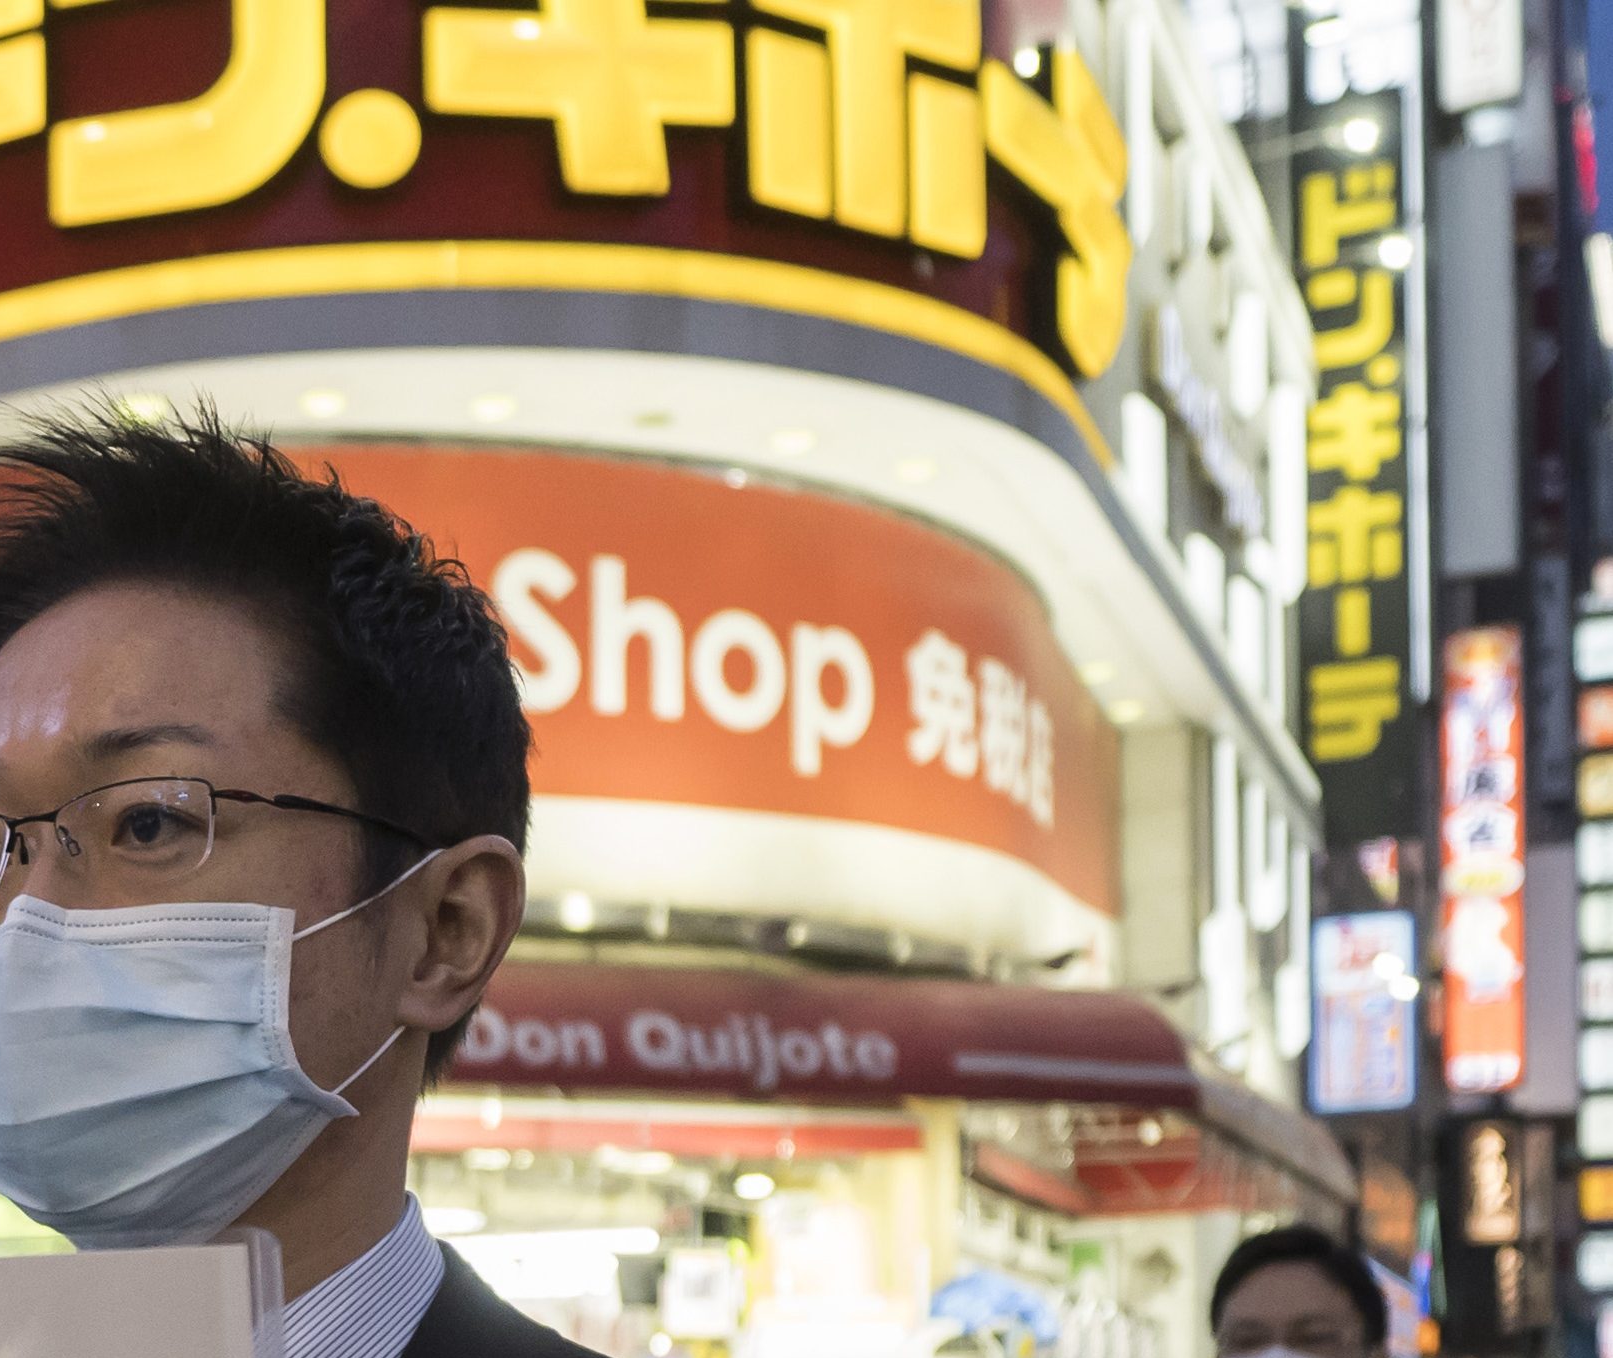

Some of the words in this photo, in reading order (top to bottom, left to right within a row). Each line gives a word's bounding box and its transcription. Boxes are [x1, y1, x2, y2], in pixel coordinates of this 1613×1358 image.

[492, 546, 876, 777] Shop
[464, 1009, 606, 1068] Don
[626, 1011, 898, 1089] Quijote
